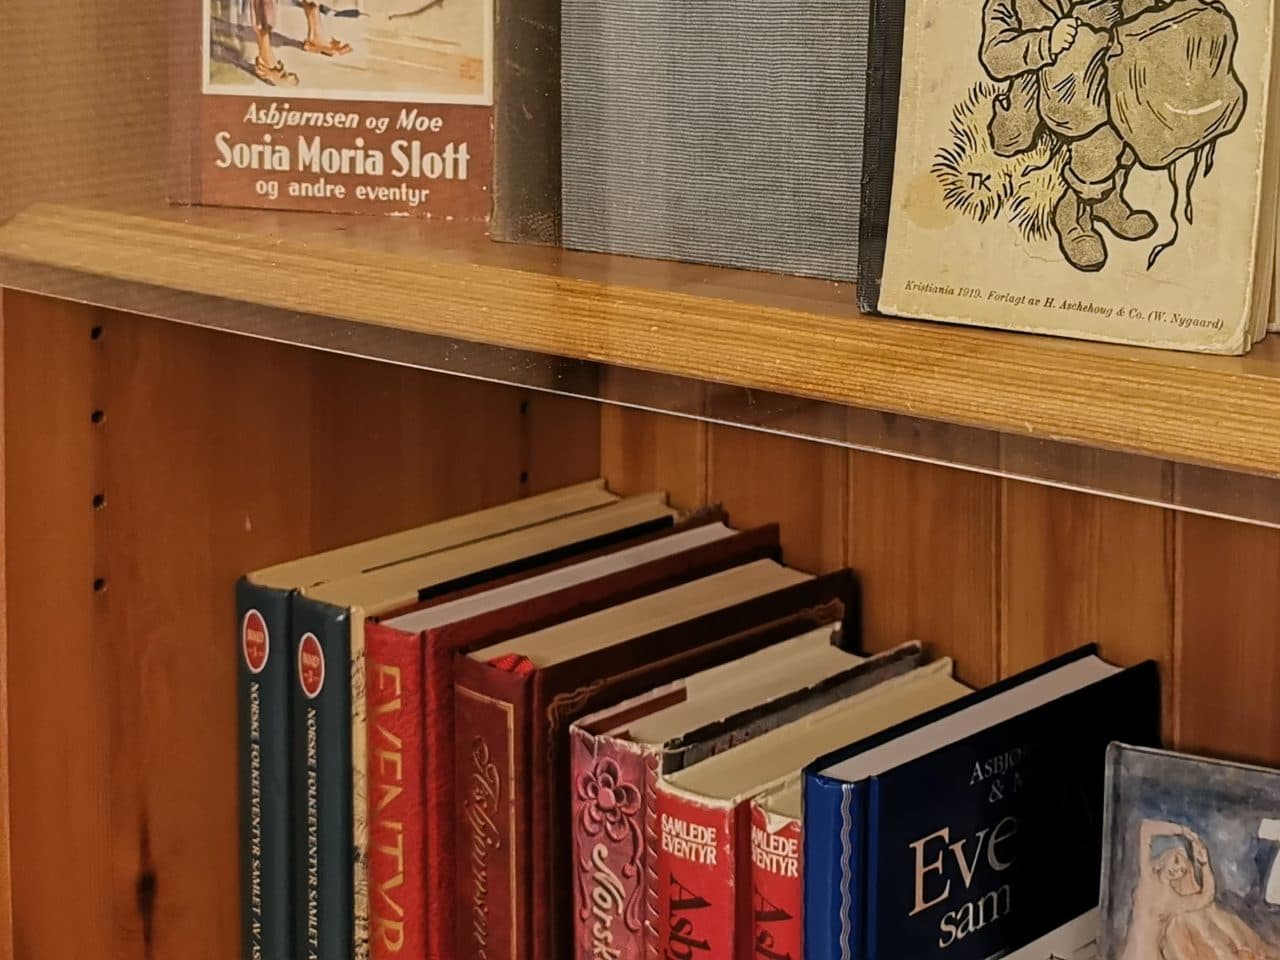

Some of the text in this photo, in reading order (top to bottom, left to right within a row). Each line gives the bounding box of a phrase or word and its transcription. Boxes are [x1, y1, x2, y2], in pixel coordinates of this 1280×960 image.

[244, 102, 443, 134] Asbjørnsen og Moe
[214, 131, 470, 180] Soria Moria Slott
[255, 178, 430, 206] og andre eventyr
[904, 279, 1224, 331] Kristiania 1919. Forlagt av H. Aschehoug & Co. (W. Nygaard)
[307, 707, 317, 768] NORSKE
[661, 813, 717, 846] SAMLEDE
[751, 825, 798, 858] AMLEDE
[661, 834, 717, 865] EVENTYR
[751, 843, 798, 877] VENTYR
